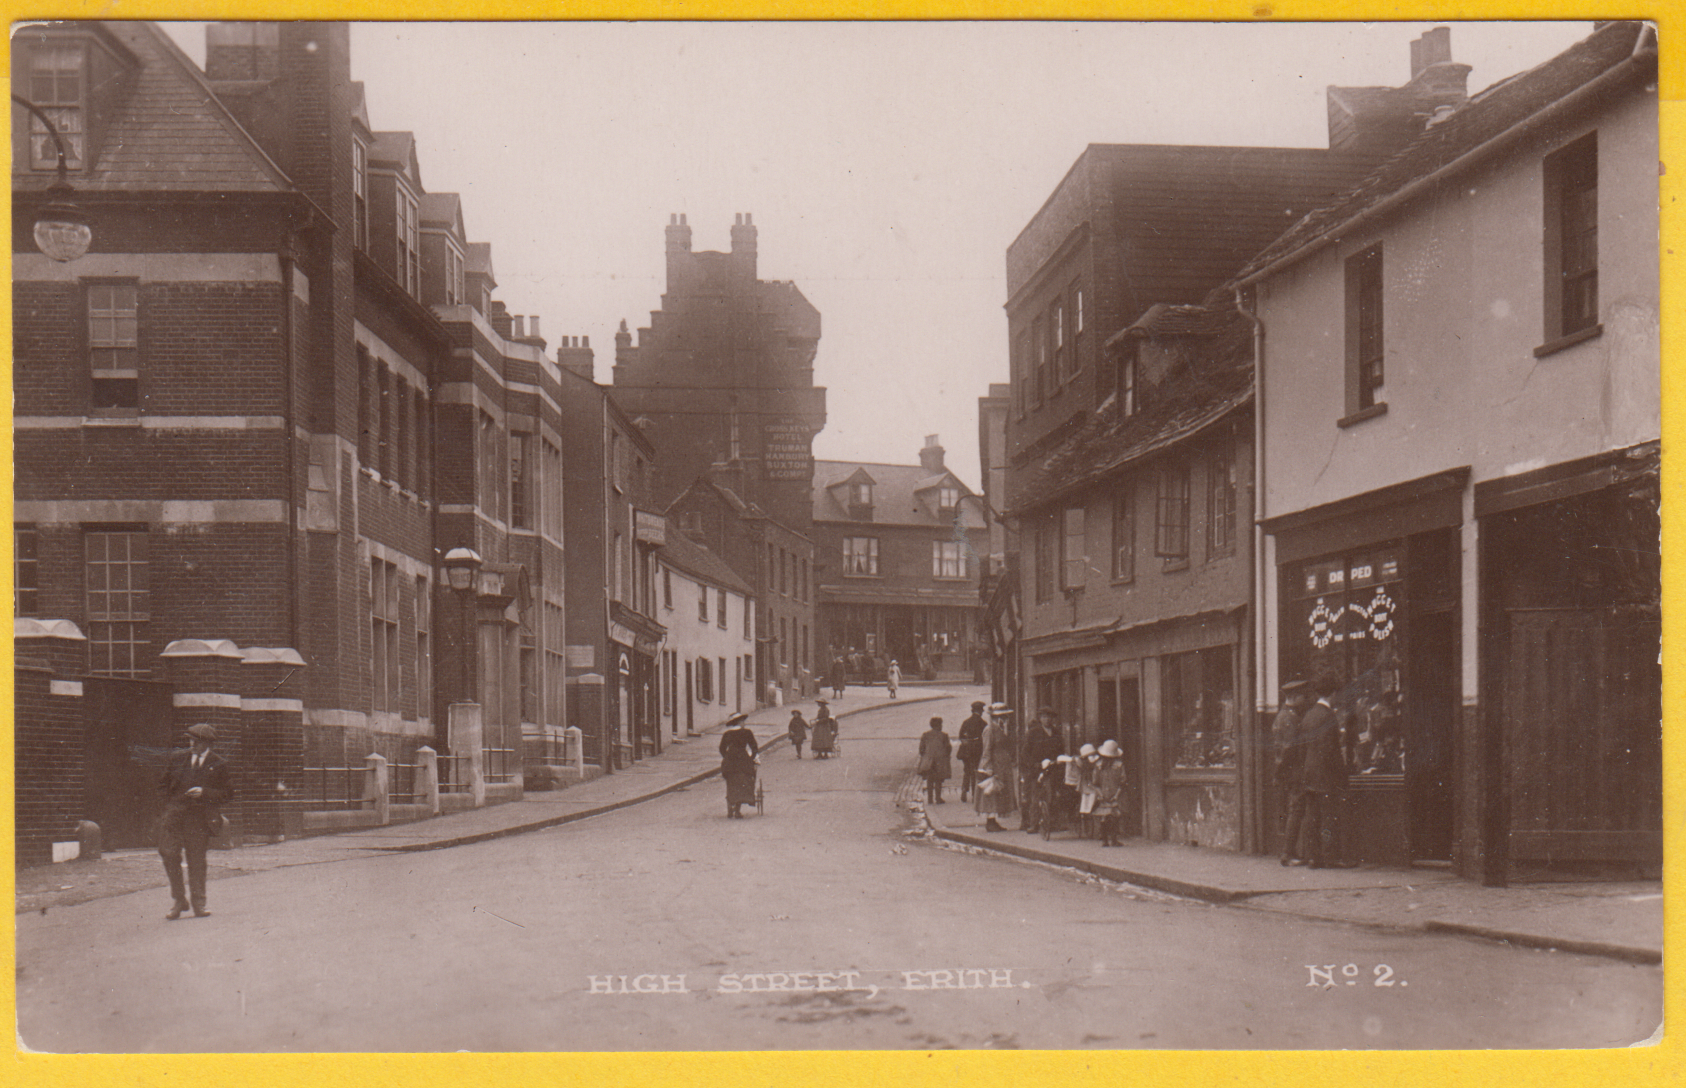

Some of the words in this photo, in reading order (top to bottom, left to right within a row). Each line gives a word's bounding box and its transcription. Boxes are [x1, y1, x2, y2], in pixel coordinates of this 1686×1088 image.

[773, 433, 802, 441] HOTEL
[767, 444, 808, 452] TRUMAN
[766, 461, 808, 469] BUXTON
[1367, 594, 1396, 616] NUGGET
[1369, 619, 1394, 640] POLISH
